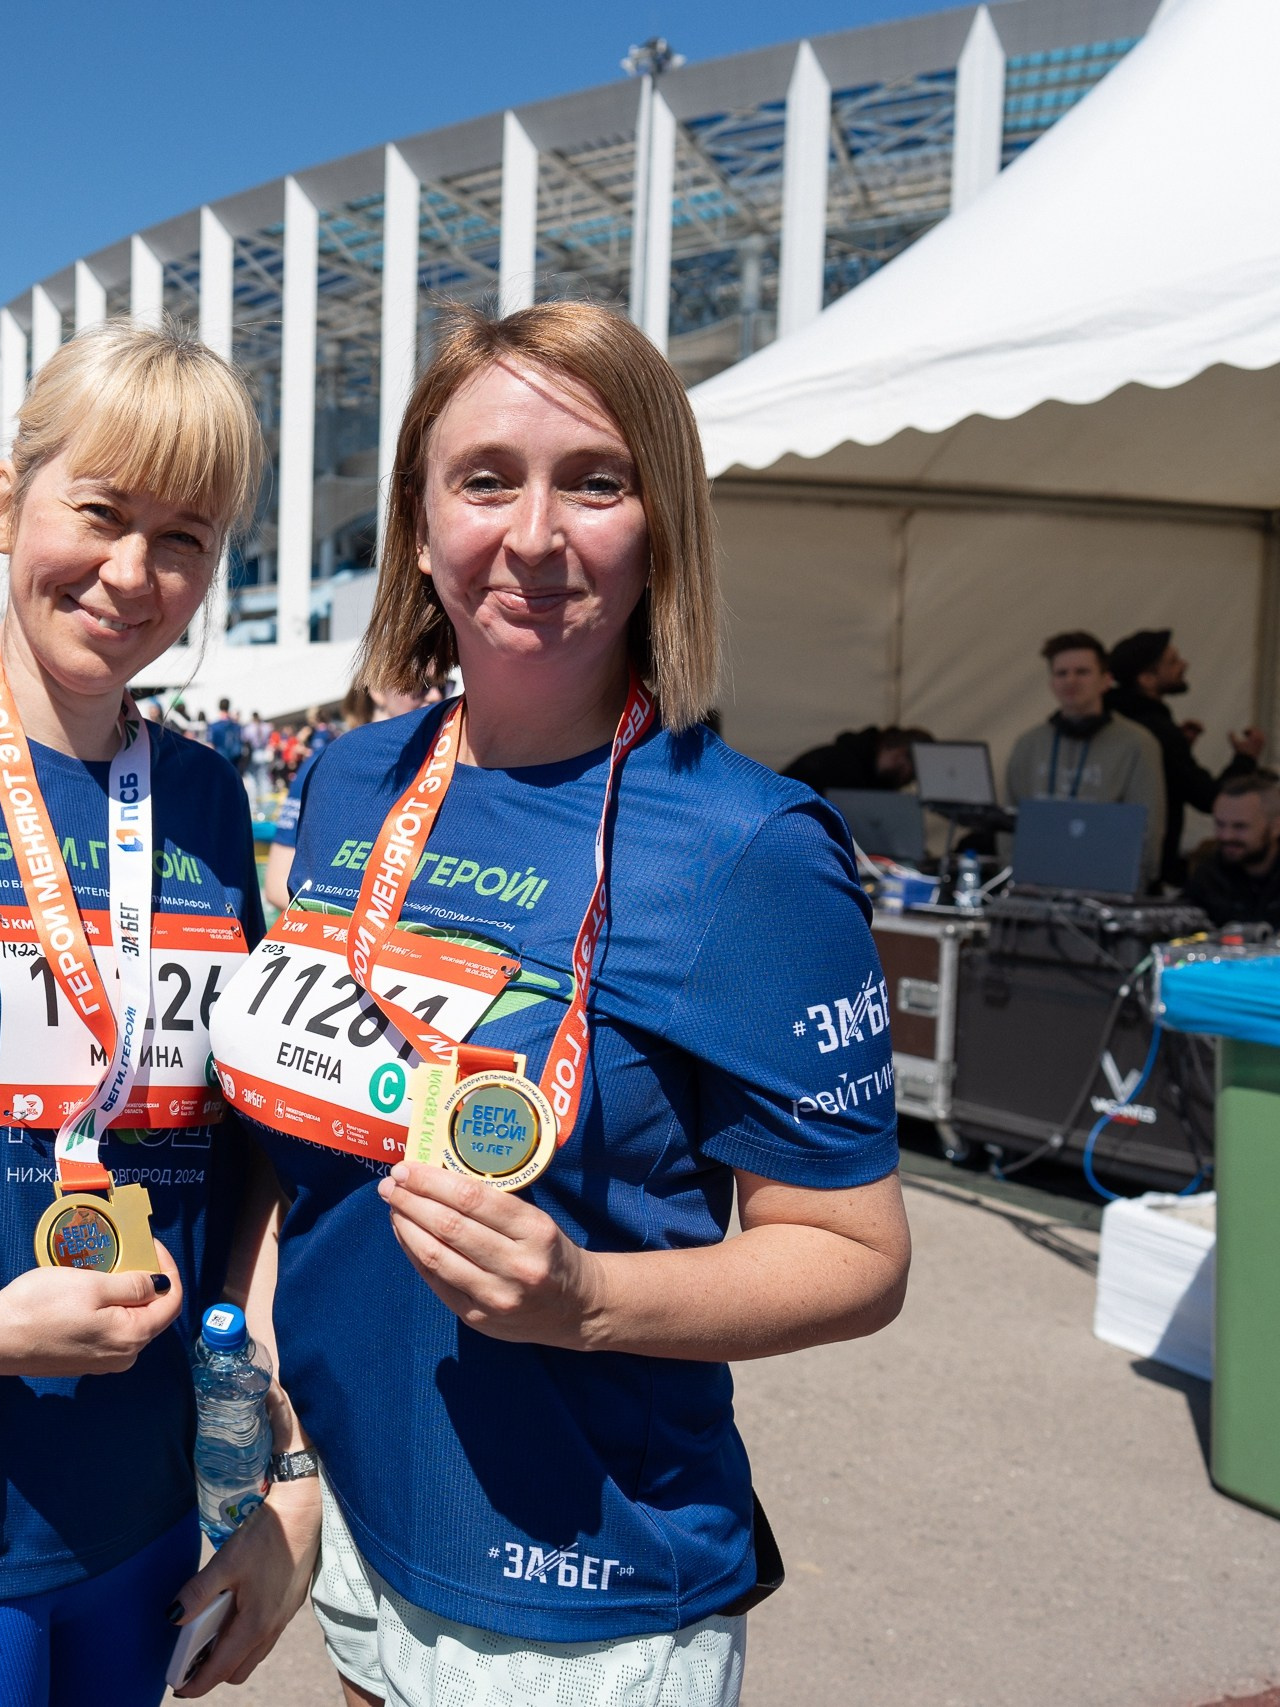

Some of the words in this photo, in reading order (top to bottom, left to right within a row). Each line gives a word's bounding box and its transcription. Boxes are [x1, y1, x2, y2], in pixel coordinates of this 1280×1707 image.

[120, 772, 139, 821] ПСБ
[3, 769, 63, 903] МЕНЯЮТ
[365, 797, 429, 930] МЕНЯЮТ
[315, 883, 324, 892] 10
[412, 852, 549, 910] ГЕРОЙ!
[1, 918, 10, 929] 5
[42, 904, 101, 1016] ГЕРОИ
[90, 1044, 184, 1068] МИНА
[276, 1041, 343, 1084] ЕЛЕНА
[461, 1119, 527, 1142] ГЕРОЙ!
[470, 1142, 485, 1153] 10
[486, 1143, 513, 1156] ЛЕТ
[174, 1169, 205, 1183] 2024
